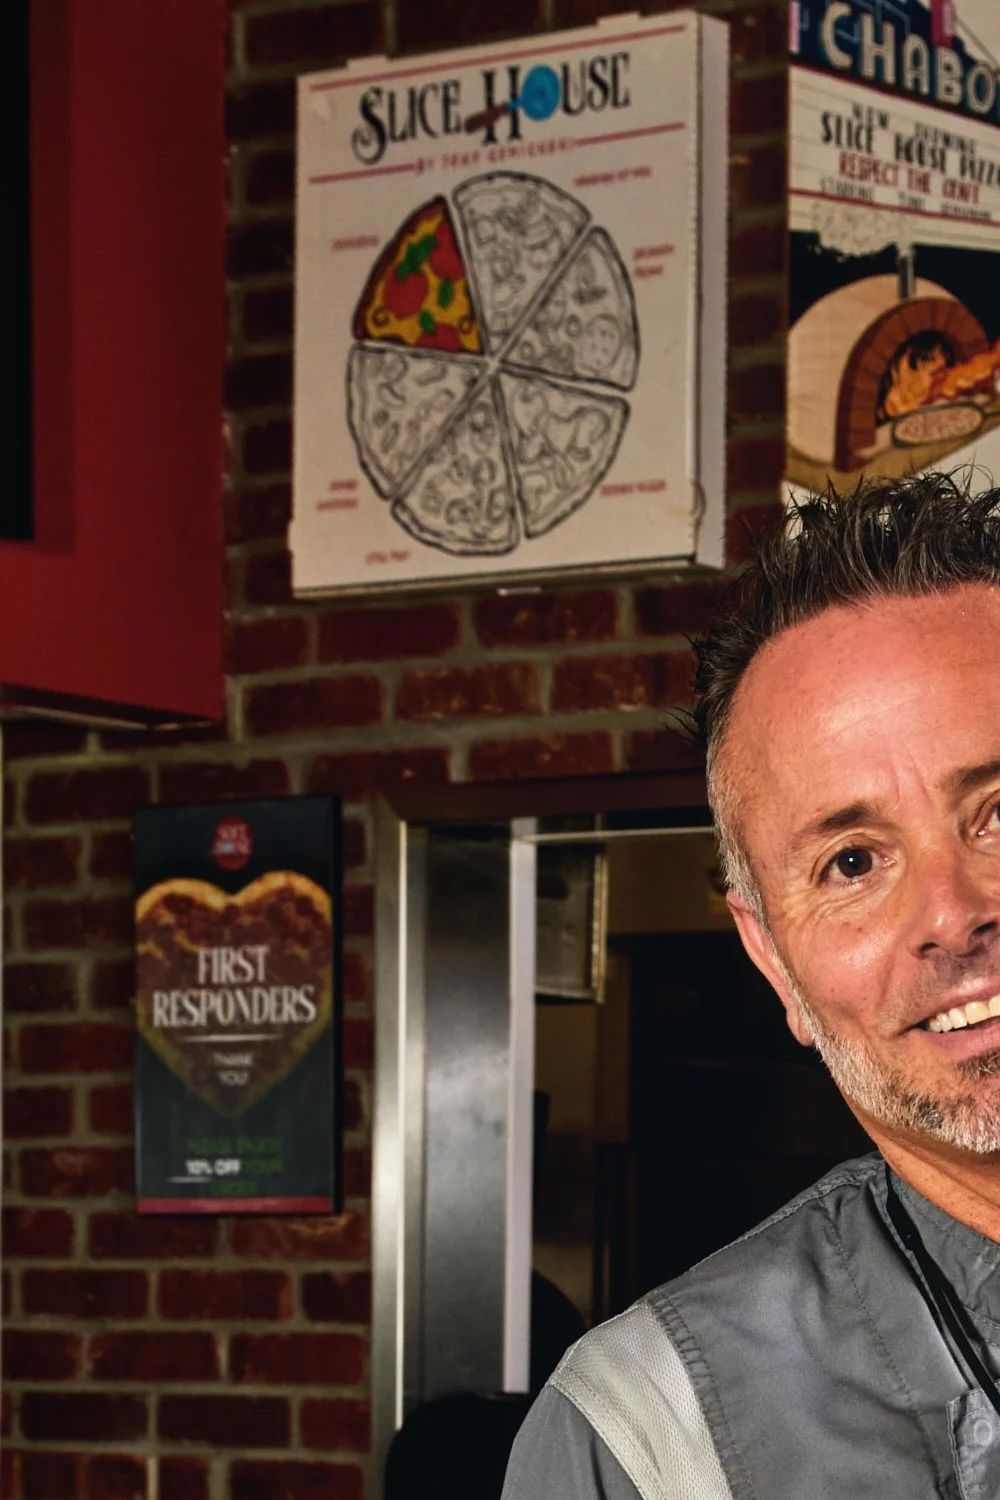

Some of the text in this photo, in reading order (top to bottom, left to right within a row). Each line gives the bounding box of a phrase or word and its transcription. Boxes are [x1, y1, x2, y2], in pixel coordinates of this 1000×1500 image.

[352, 51, 631, 165] SLICE HOUSE
[821, 111, 873, 153] SLICE
[894, 133, 947, 173] HOUSE
[839, 151, 898, 187] RESPECT
[907, 166, 931, 194] THE
[198, 944, 270, 985] FIRST
[153, 984, 317, 1029] RESPONDERS
